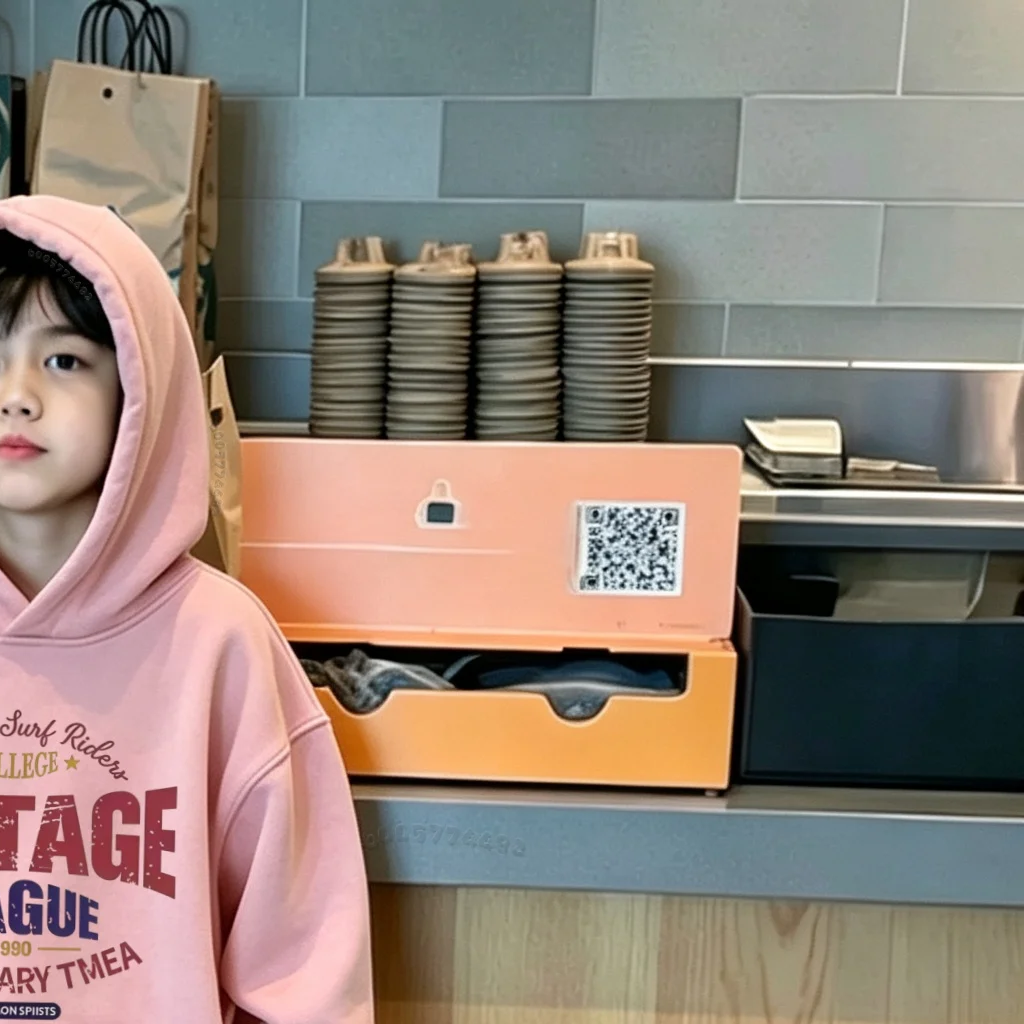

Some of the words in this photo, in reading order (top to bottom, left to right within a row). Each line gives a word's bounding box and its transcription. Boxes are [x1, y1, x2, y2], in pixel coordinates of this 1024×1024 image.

[0, 709, 57, 748] Surf
[60, 722, 129, 781] Riders
[56, 940, 143, 990] TMEA
